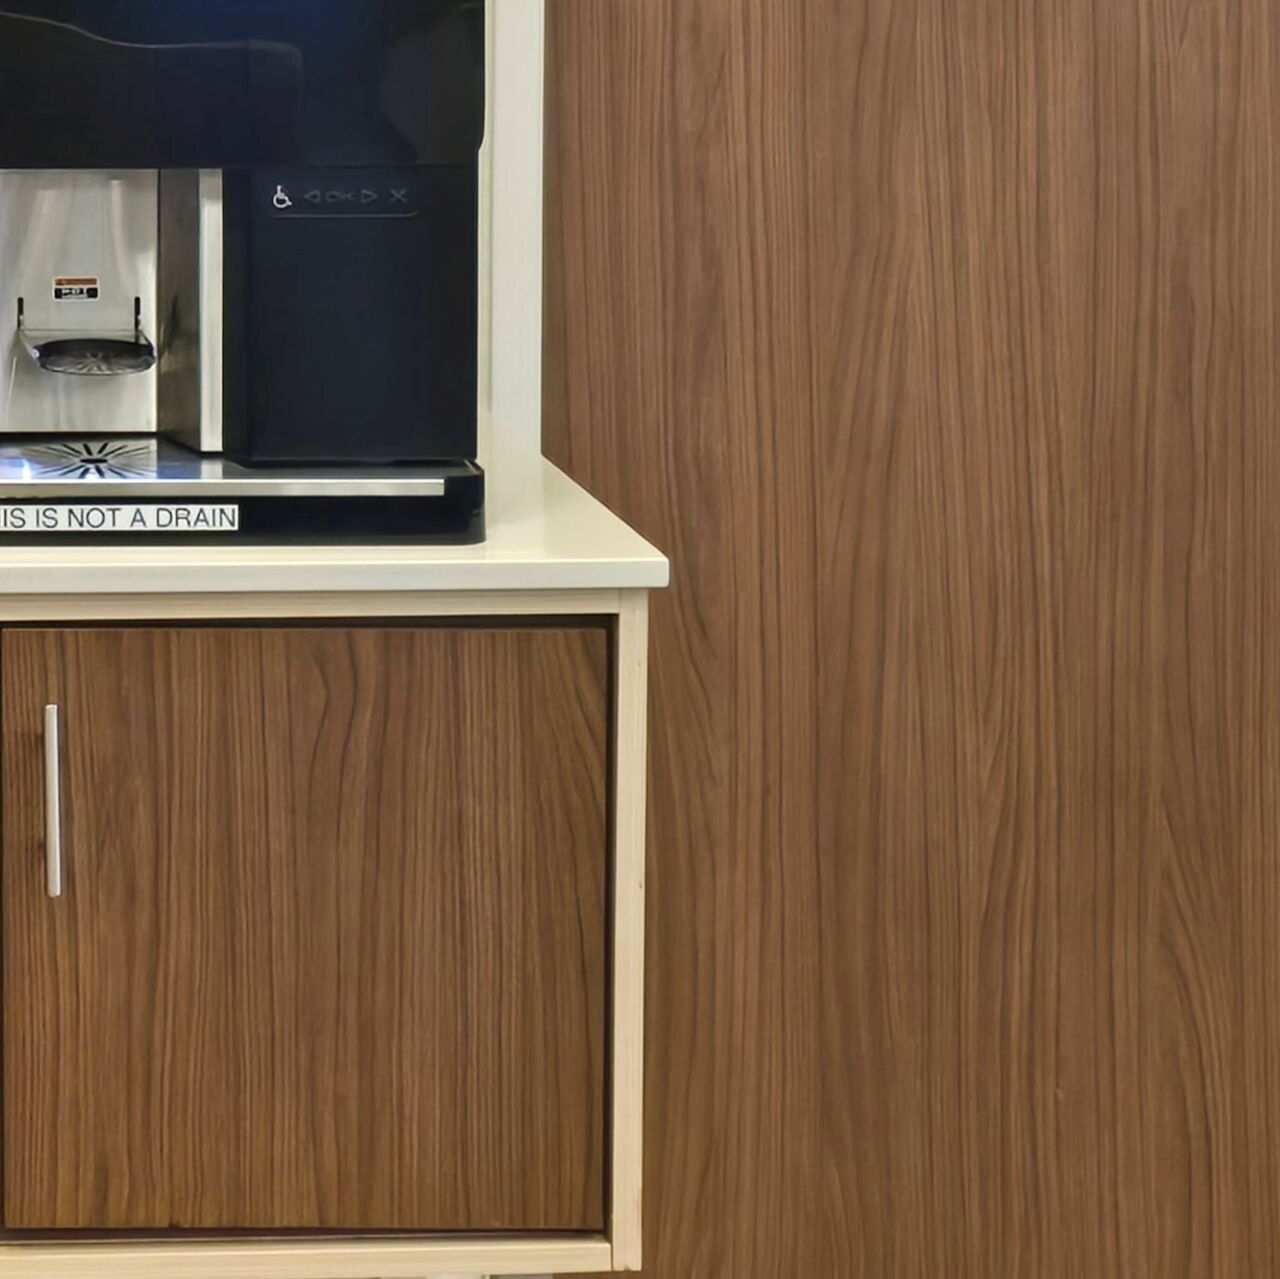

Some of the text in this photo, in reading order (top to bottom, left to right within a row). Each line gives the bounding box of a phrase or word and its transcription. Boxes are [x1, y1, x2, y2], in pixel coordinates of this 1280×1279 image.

[36, 507, 58, 529] IS
[68, 507, 121, 529] NOT
[130, 507, 147, 529] A
[156, 507, 237, 529] DRAIN
